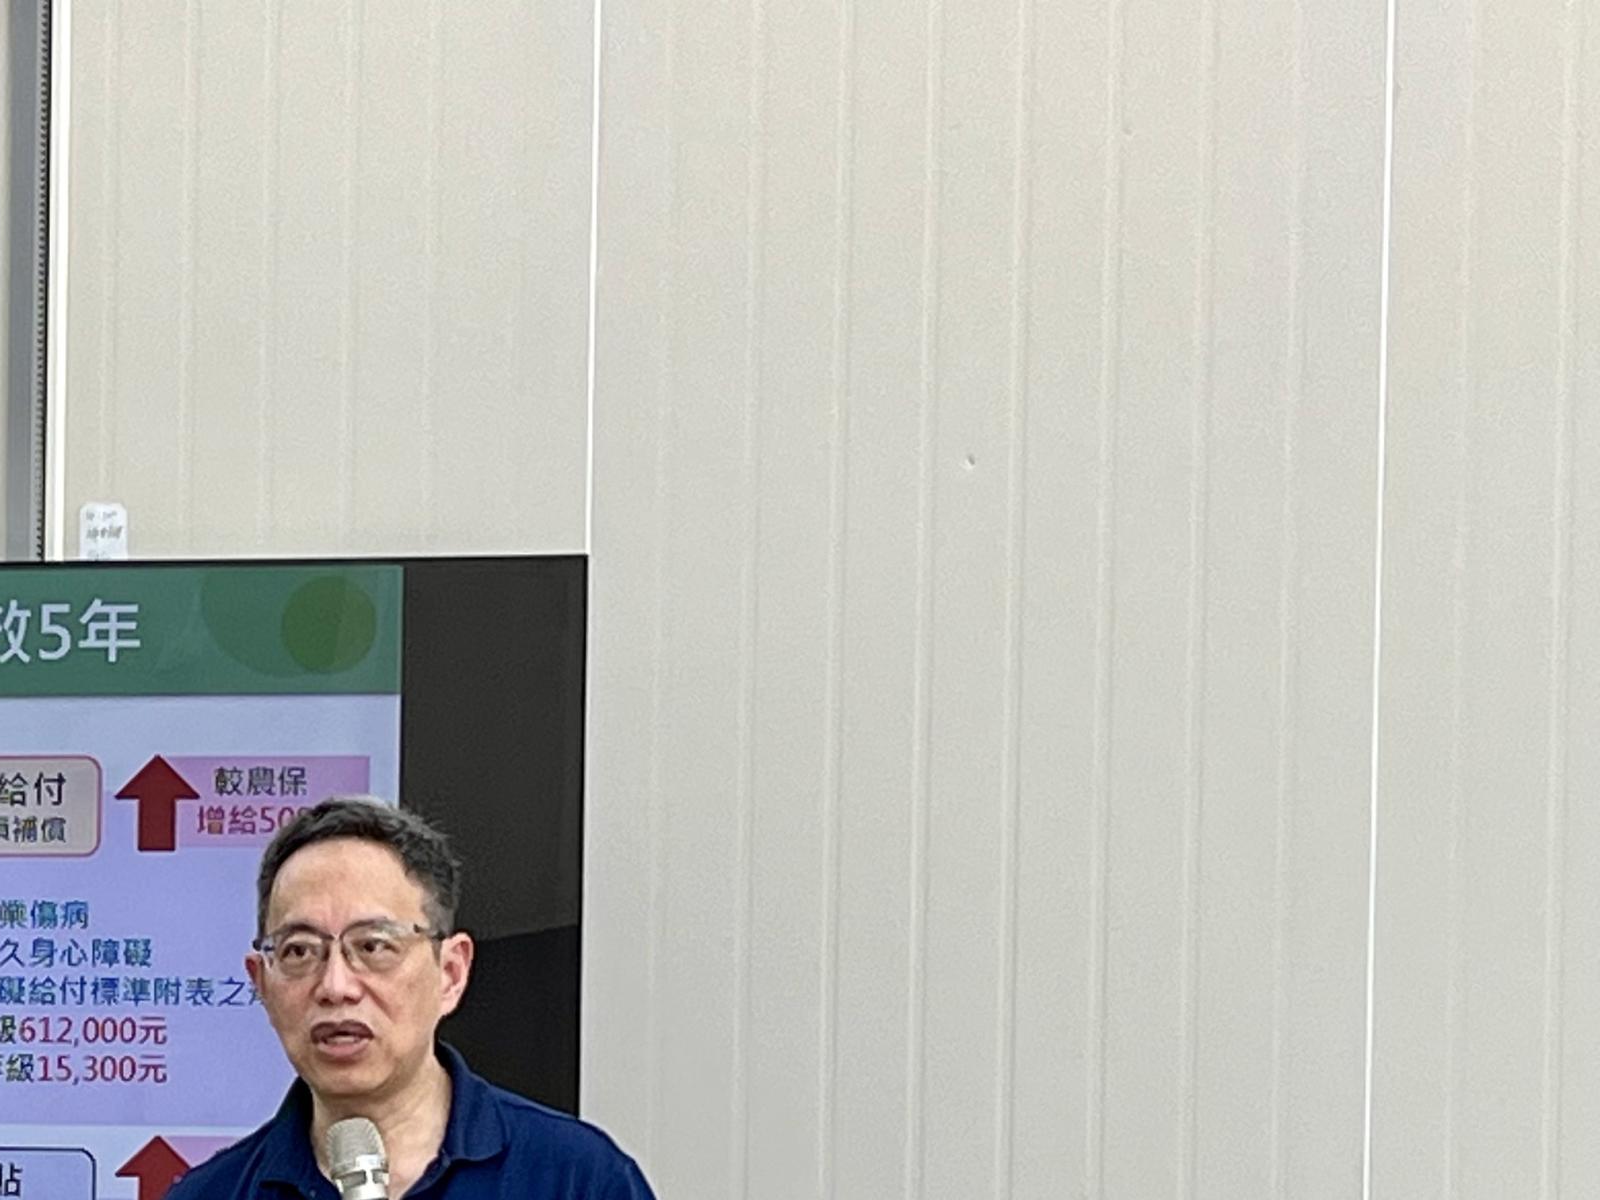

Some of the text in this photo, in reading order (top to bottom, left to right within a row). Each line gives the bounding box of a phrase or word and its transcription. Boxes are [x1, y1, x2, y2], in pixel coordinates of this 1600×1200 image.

[214, 766, 308, 796] 較農保
[197, 805, 311, 835] 增給50
